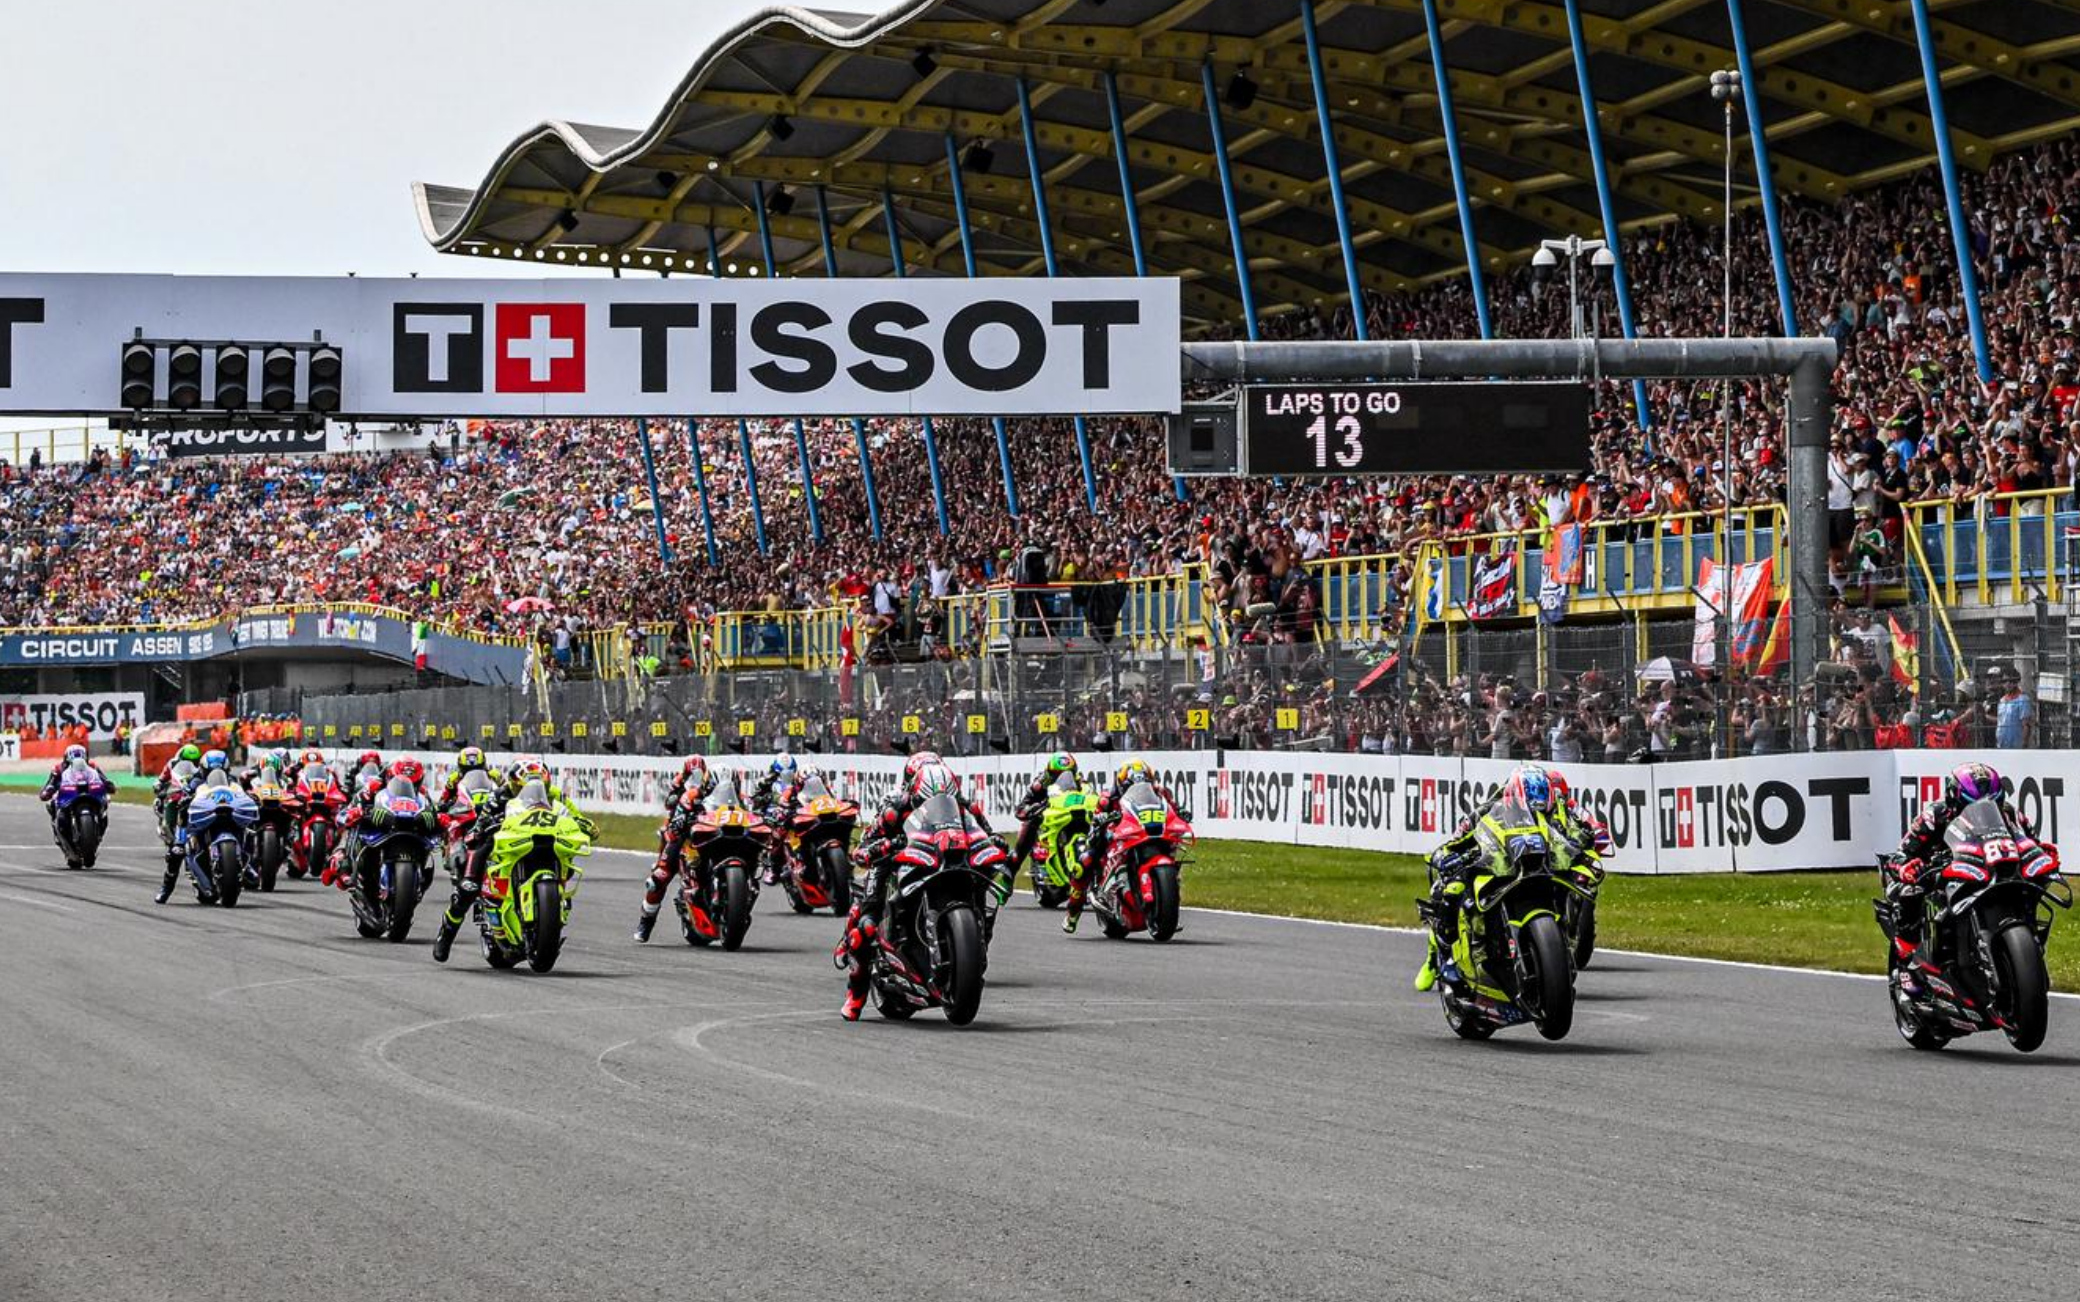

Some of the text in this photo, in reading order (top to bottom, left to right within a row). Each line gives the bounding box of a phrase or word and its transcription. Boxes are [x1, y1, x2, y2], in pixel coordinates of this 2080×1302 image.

[610, 299, 1140, 393] TISSOT
[1266, 392, 1400, 416] LAPS TO GO
[1305, 416, 1364, 468] 13
[21, 639, 118, 658] CIRCUIT
[131, 636, 182, 655] ASSEN
[30, 701, 136, 735] TISSOT
[1113, 715, 1121, 730] 3
[1195, 712, 1203, 727] 2
[814, 799, 838, 812] 23
[1231, 770, 1294, 823] TISSOT
[1327, 774, 1395, 831] TISSOT
[519, 810, 558, 827] 49
[718, 810, 745, 824] 37
[1138, 810, 1166, 824] 36
[1696, 776, 1870, 847] TISSOT
